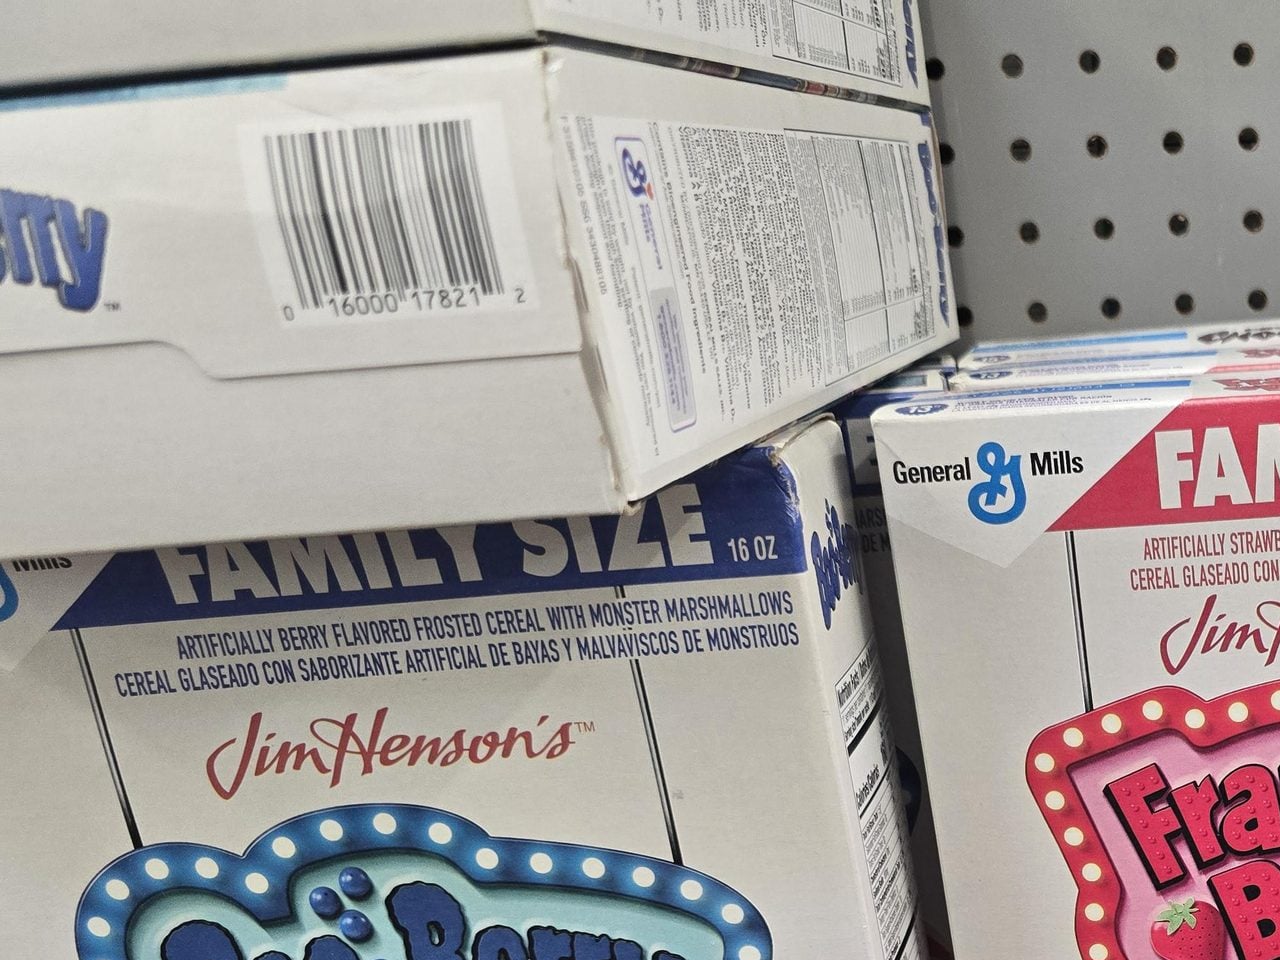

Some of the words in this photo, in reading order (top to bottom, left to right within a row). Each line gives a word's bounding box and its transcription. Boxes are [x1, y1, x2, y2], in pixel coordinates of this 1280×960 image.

[282, 304, 296, 321] 0
[328, 293, 400, 318] 16000
[411, 287, 481, 312] 17821
[514, 288, 527, 304] 2
[893, 456, 972, 484] General
[1030, 449, 1085, 477] Mills
[512, 483, 714, 578] SIZE
[727, 537, 750, 562] 16
[754, 535, 779, 561] OZ
[1143, 533, 1225, 561] ARTIFICIALLY
[1130, 566, 1180, 591] CEREAL
[1182, 562, 1250, 587] GLASEADO
[1253, 559, 1280, 582] CON
[114, 668, 177, 698] CEREAL
[177, 662, 260, 692] GLASEADO
[261, 659, 297, 685] CON
[297, 651, 403, 682] SABORIZANTE
[404, 643, 487, 673] ARTIFICIAL
[488, 641, 511, 667] DE
[511, 638, 561, 665] BAYAS
[561, 637, 573, 661] Y
[579, 631, 680, 661] MALVAVISCOS
[684, 629, 705, 653] DE
[707, 622, 800, 651] MONSTRUOS
[176, 628, 272, 661] ARTIFICIALLY
[277, 624, 327, 651] BERRY
[332, 618, 411, 648] FLAVORED
[413, 611, 481, 641] FROSTED
[485, 607, 545, 637] CEREAL
[550, 603, 587, 632] WITH
[590, 599, 661, 628] MONSTER
[664, 590, 794, 624] MARSHMALLOWS
[1160, 594, 1269, 675] Jim
[206, 711, 331, 801] Jim
